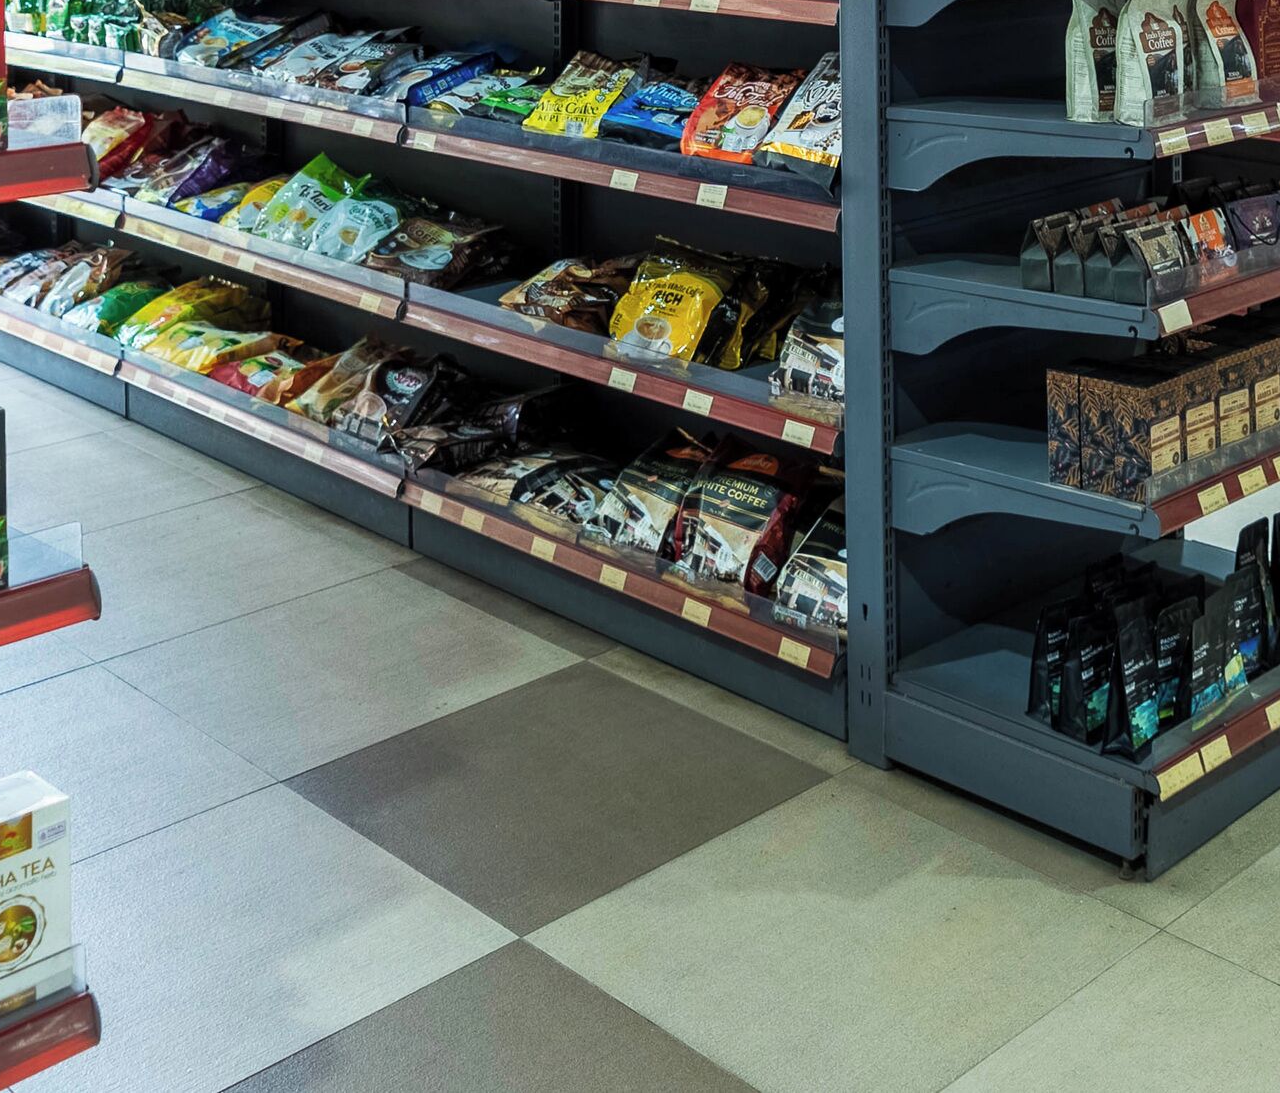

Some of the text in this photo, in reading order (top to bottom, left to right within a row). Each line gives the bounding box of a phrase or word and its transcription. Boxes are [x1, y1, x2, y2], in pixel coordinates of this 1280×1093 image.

[1145, 32, 1159, 41] Indo
[1147, 38, 1174, 50] Coffee
[651, 289, 684, 306] RICH
[696, 479, 769, 510] WHITE COFFEE
[712, 473, 760, 496] PREMIUM
[20, 856, 56, 880] TEA
